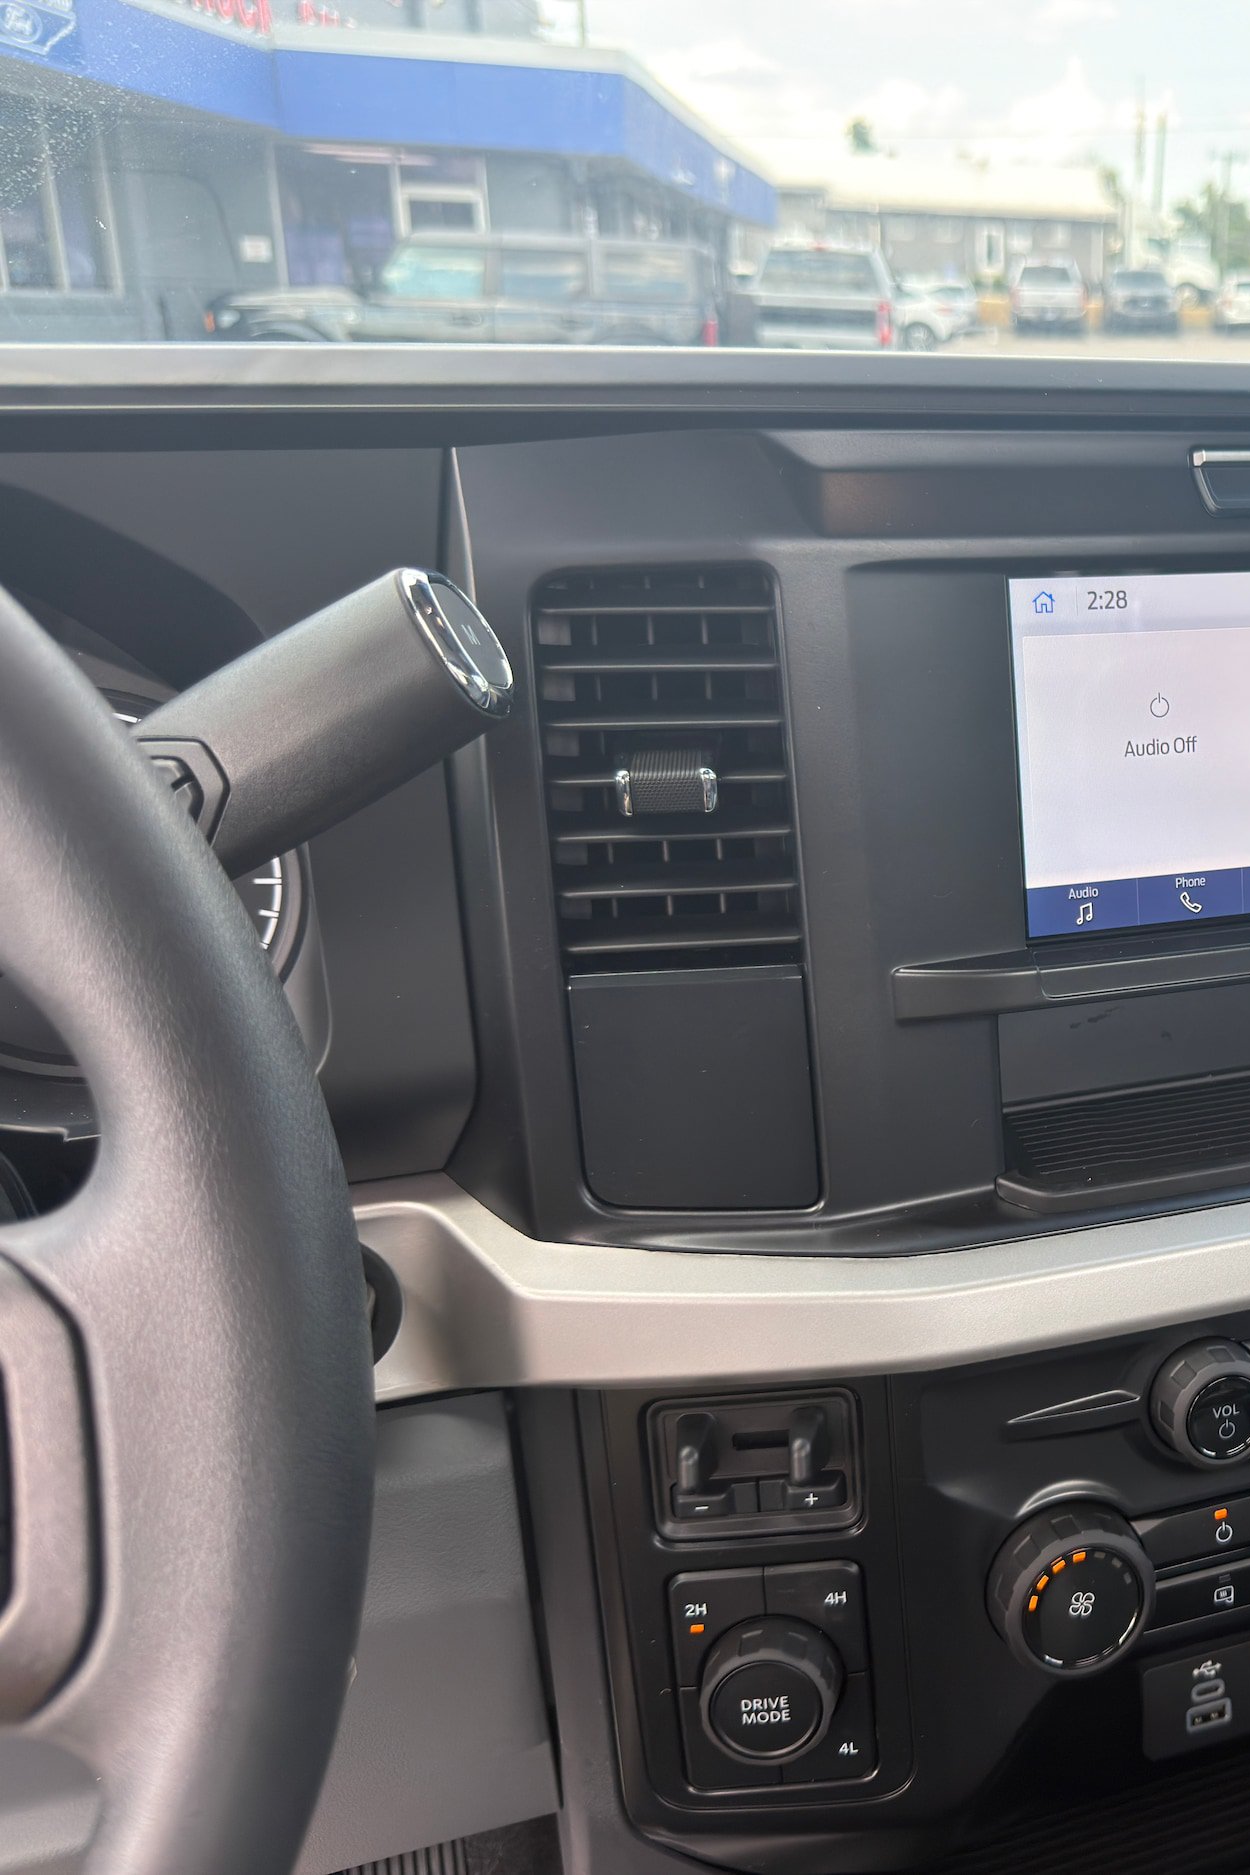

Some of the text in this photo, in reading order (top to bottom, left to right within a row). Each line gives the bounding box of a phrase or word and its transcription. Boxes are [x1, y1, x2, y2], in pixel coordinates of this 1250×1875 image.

[1086, 589, 1129, 611] 2:28
[1123, 734, 1198, 758] Audio Off
[1174, 873, 1206, 890] Phone
[1067, 885, 1100, 900] Audio
[1211, 1404, 1240, 1420] VOL
[824, 1591, 848, 1606] 4H
[684, 1603, 708, 1617] 2H
[740, 1695, 790, 1712] DRIVE
[741, 1708, 792, 1725] MODE
[838, 1742, 859, 1756] 4L
